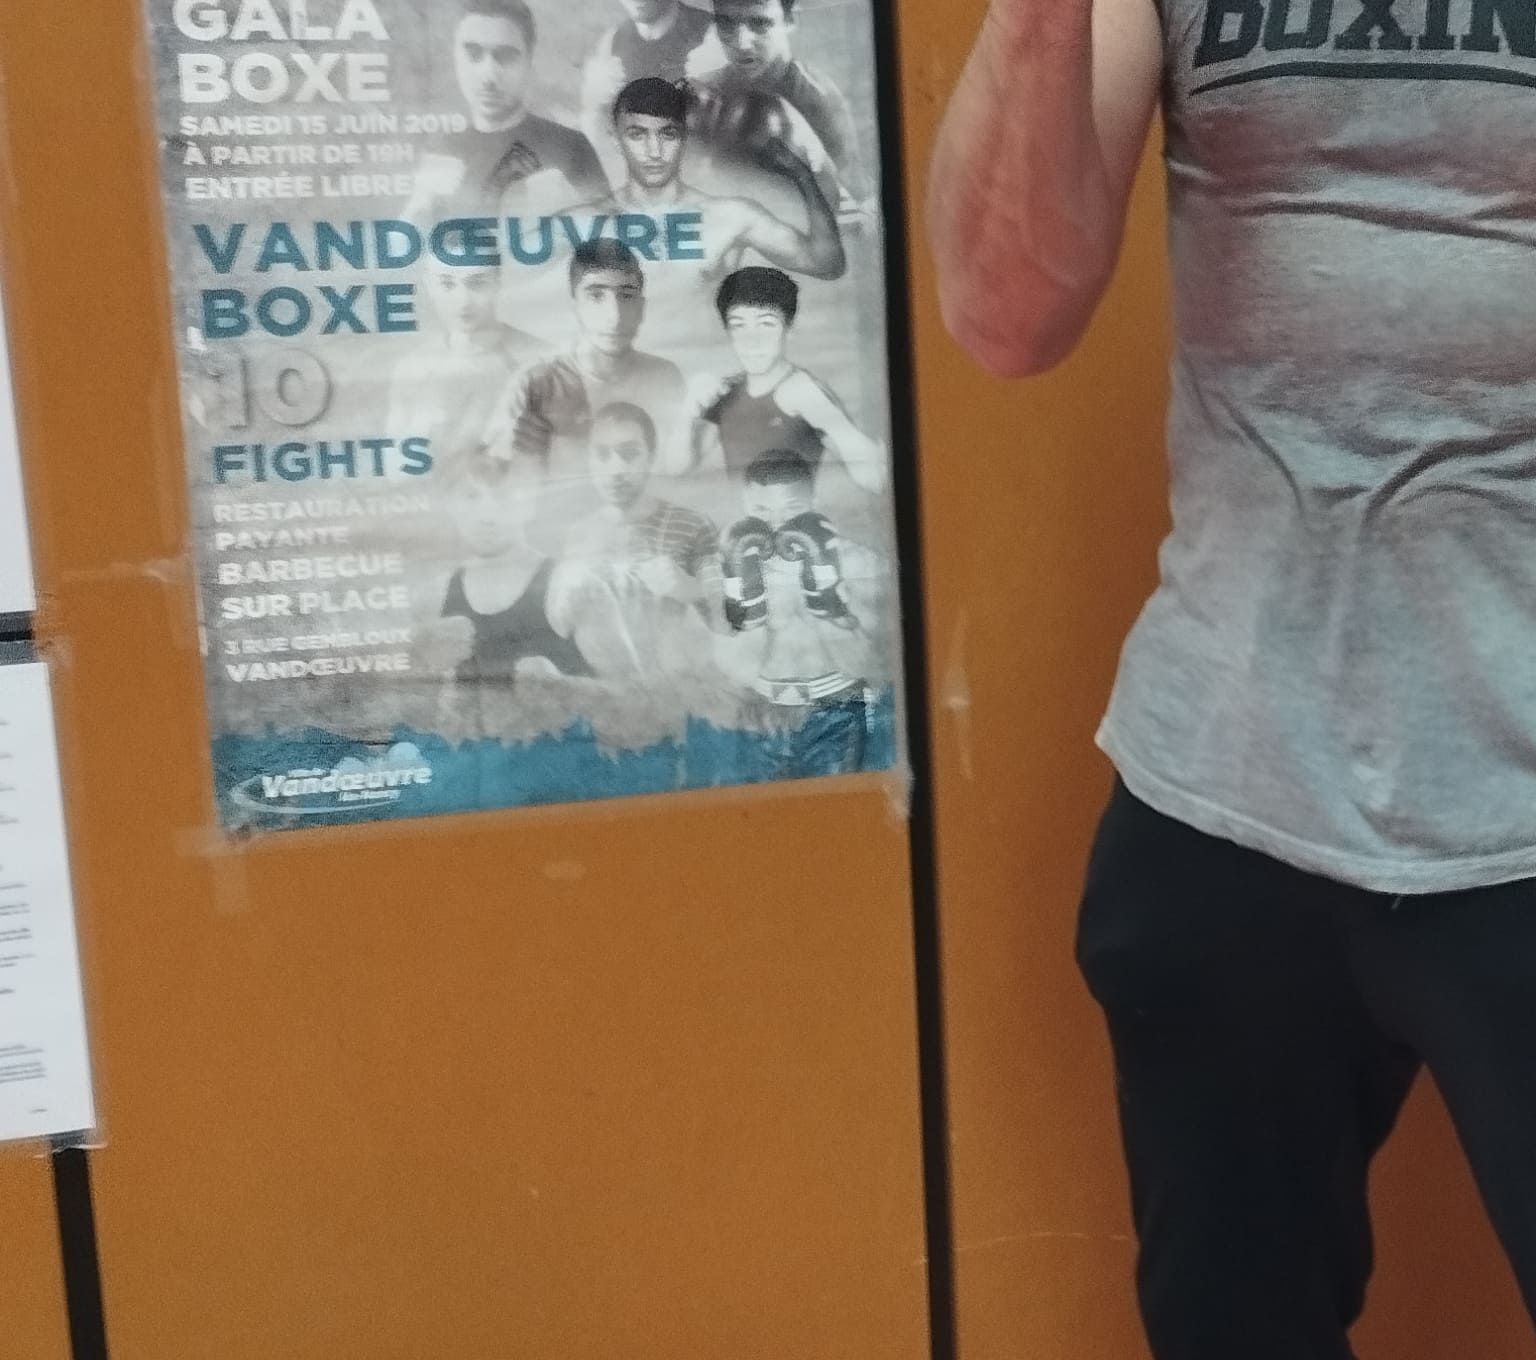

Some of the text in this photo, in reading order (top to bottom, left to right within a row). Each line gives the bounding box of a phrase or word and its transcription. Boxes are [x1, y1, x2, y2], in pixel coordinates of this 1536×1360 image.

[178, 53, 391, 104] BOXE
[180, 113, 467, 136] SAMEDI 15 JUIN 2019
[184, 141, 206, 165] À
[211, 144, 316, 165] PARTIR
[324, 143, 361, 164] DE
[185, 170, 413, 199] ENTRÉE LIBRE
[193, 212, 704, 274] VANDŒUVRE
[201, 283, 418, 339] BOXE
[203, 345, 333, 431] 10
[212, 437, 433, 484] FIGHTS
[213, 495, 431, 523] RESTAURATION
[215, 527, 349, 551] PAYANTE
[218, 553, 403, 585] BARBECUE
[221, 586, 410, 620] SUR PLACE
